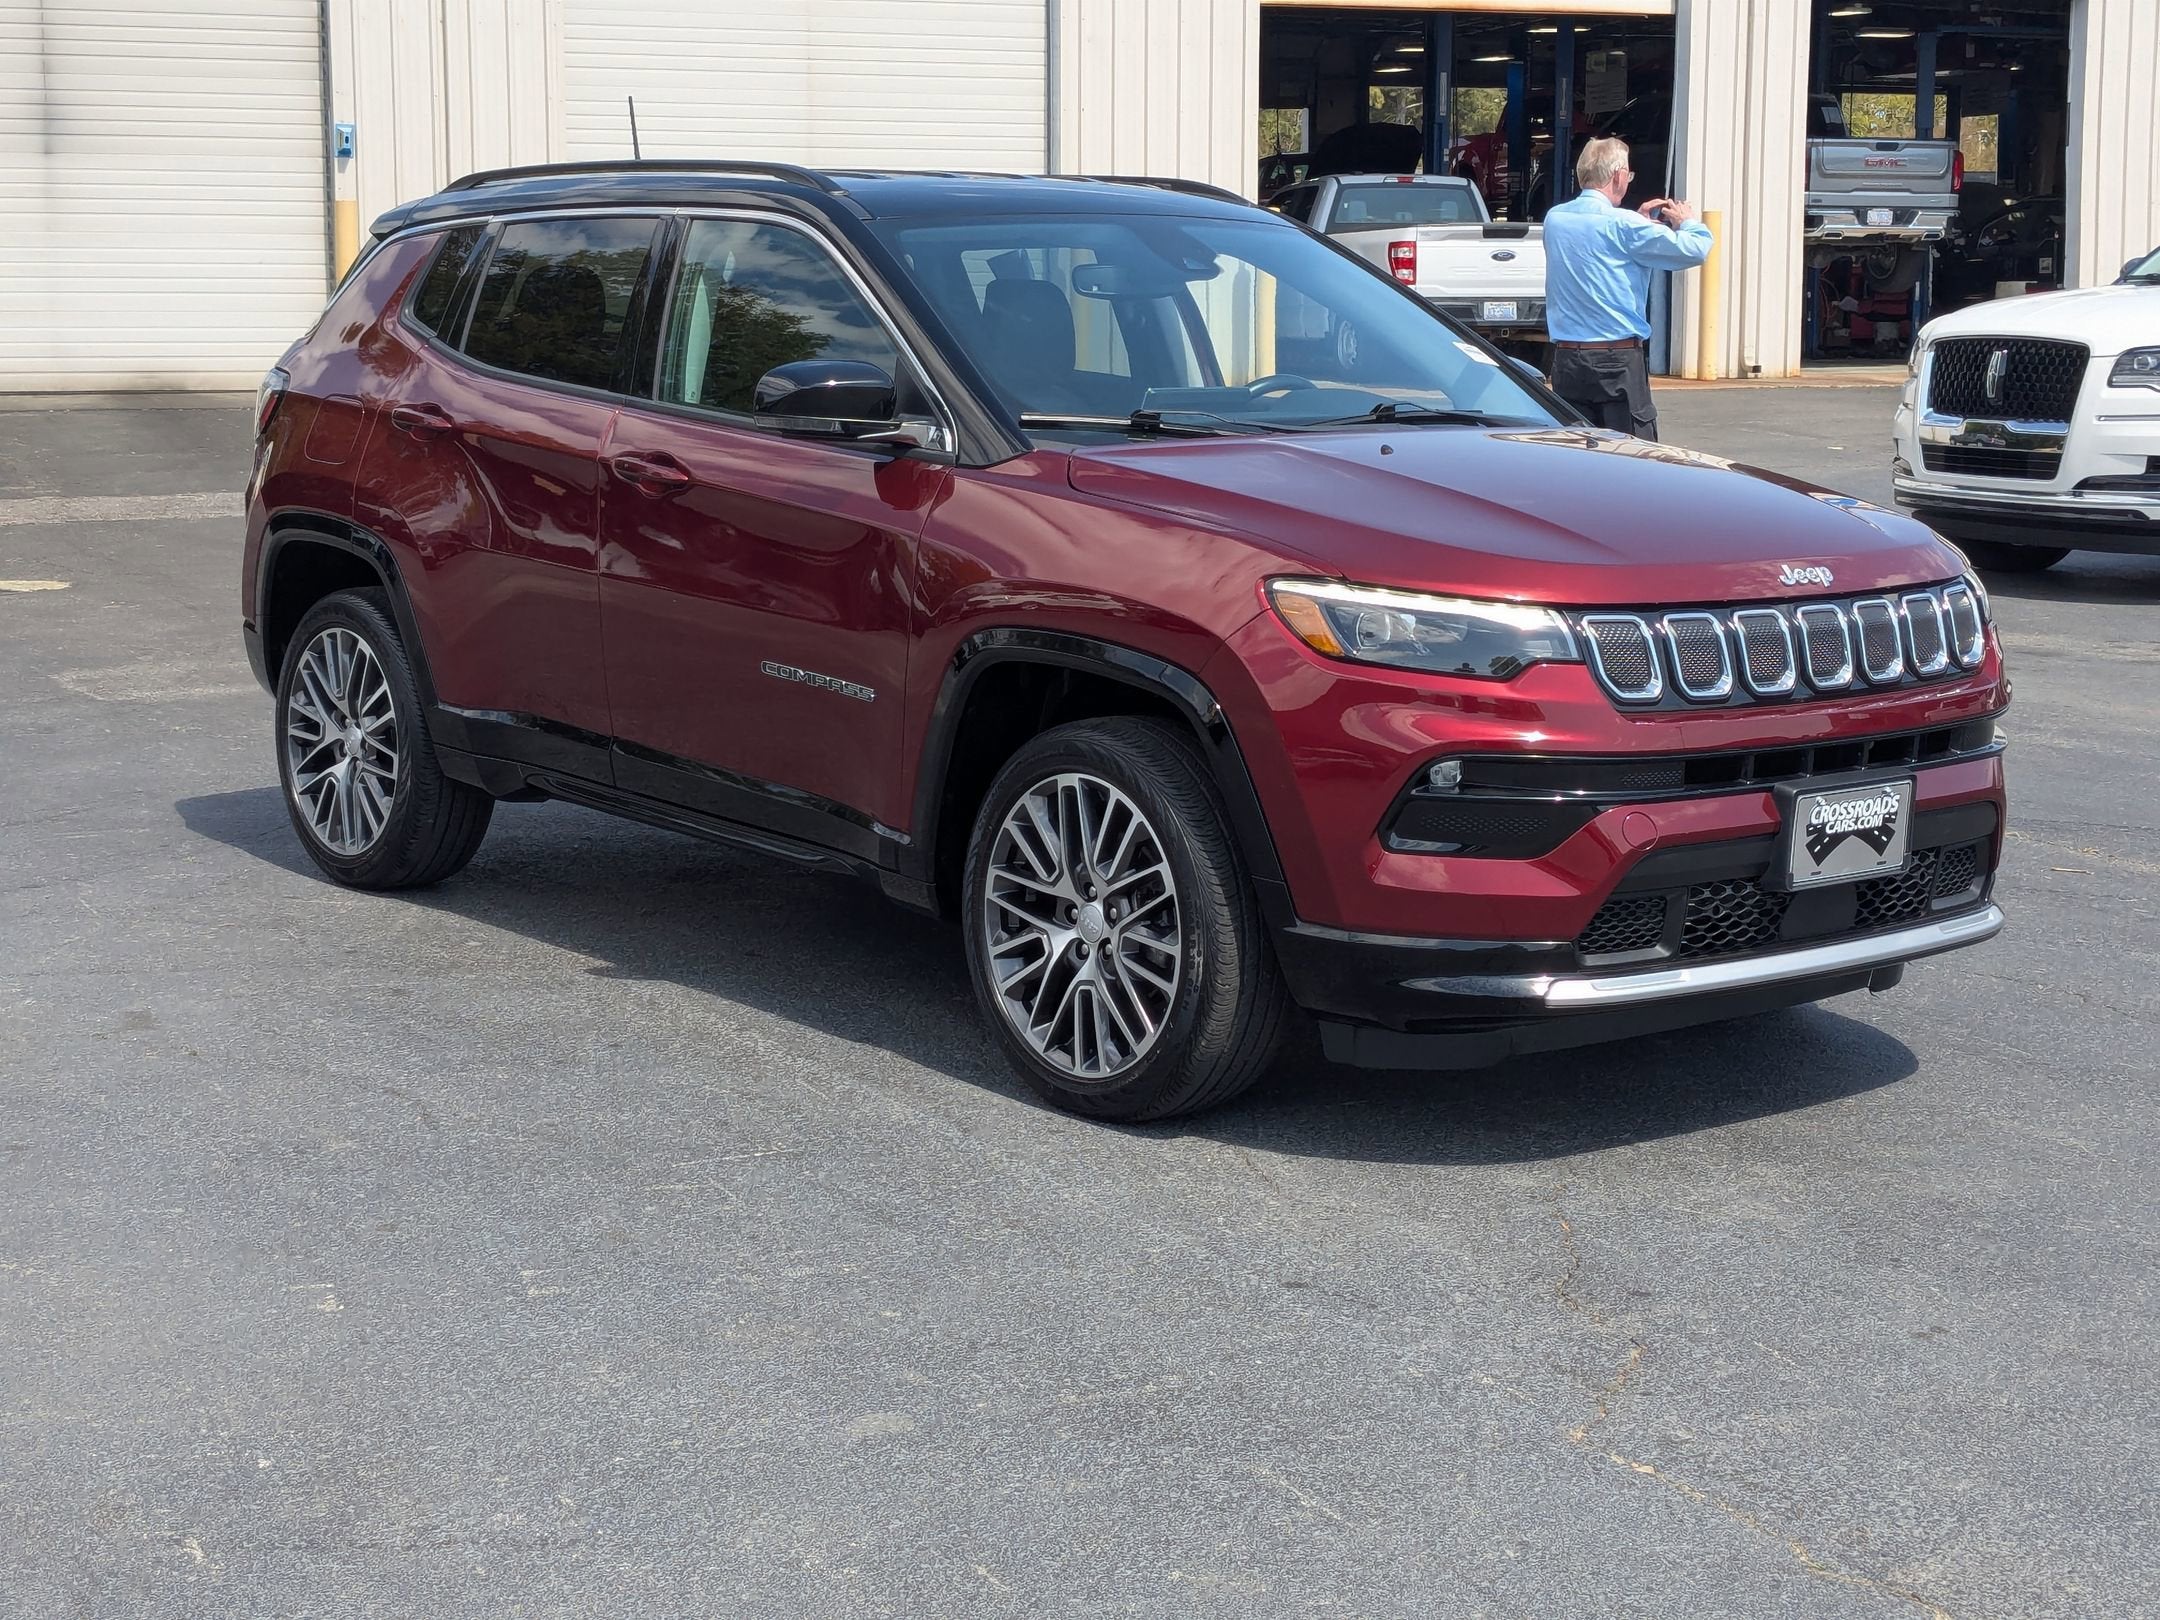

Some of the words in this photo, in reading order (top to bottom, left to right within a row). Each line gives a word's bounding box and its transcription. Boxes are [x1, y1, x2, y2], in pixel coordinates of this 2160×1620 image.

[1779, 564, 1834, 588] Jeep
[760, 660, 876, 703] COMPASS
[1810, 793, 1901, 825] CROSSROADS
[1825, 813, 1884, 834] CARS.COM
